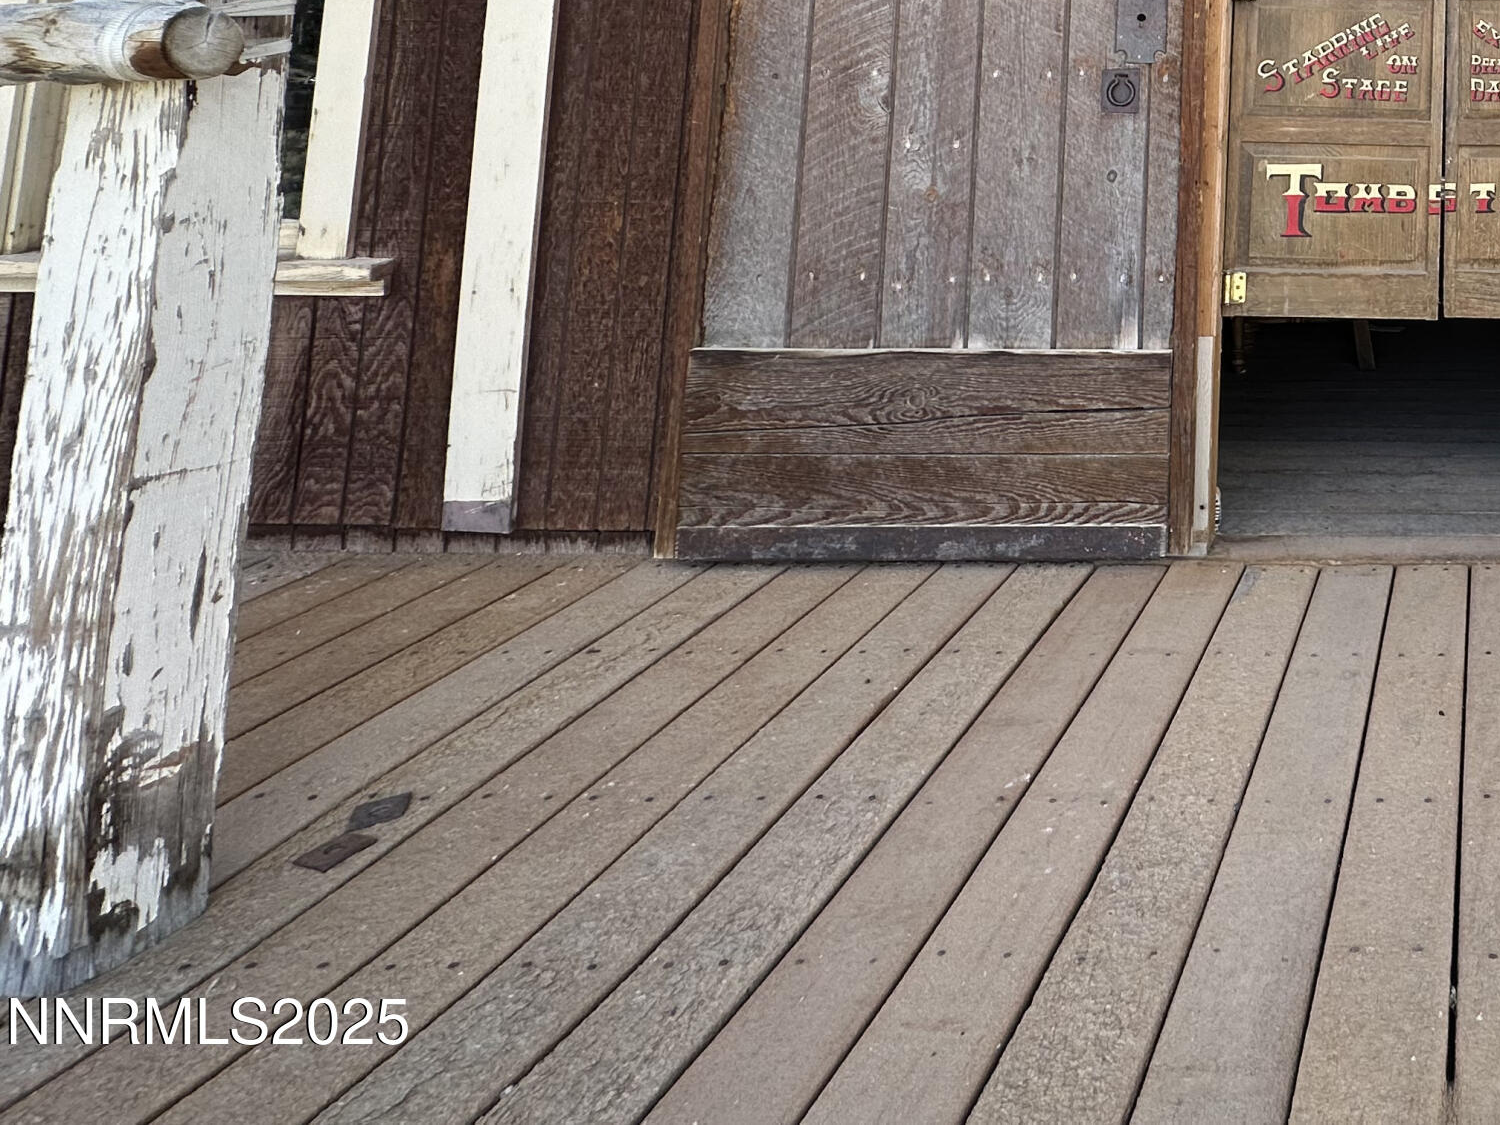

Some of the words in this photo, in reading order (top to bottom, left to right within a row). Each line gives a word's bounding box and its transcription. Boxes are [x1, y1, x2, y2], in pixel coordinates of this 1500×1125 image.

[1257, 12, 1391, 94] STARRING
[1359, 22, 1416, 60] LIVE
[1386, 54, 1418, 74] ON
[1320, 67, 1409, 102] STAGE
